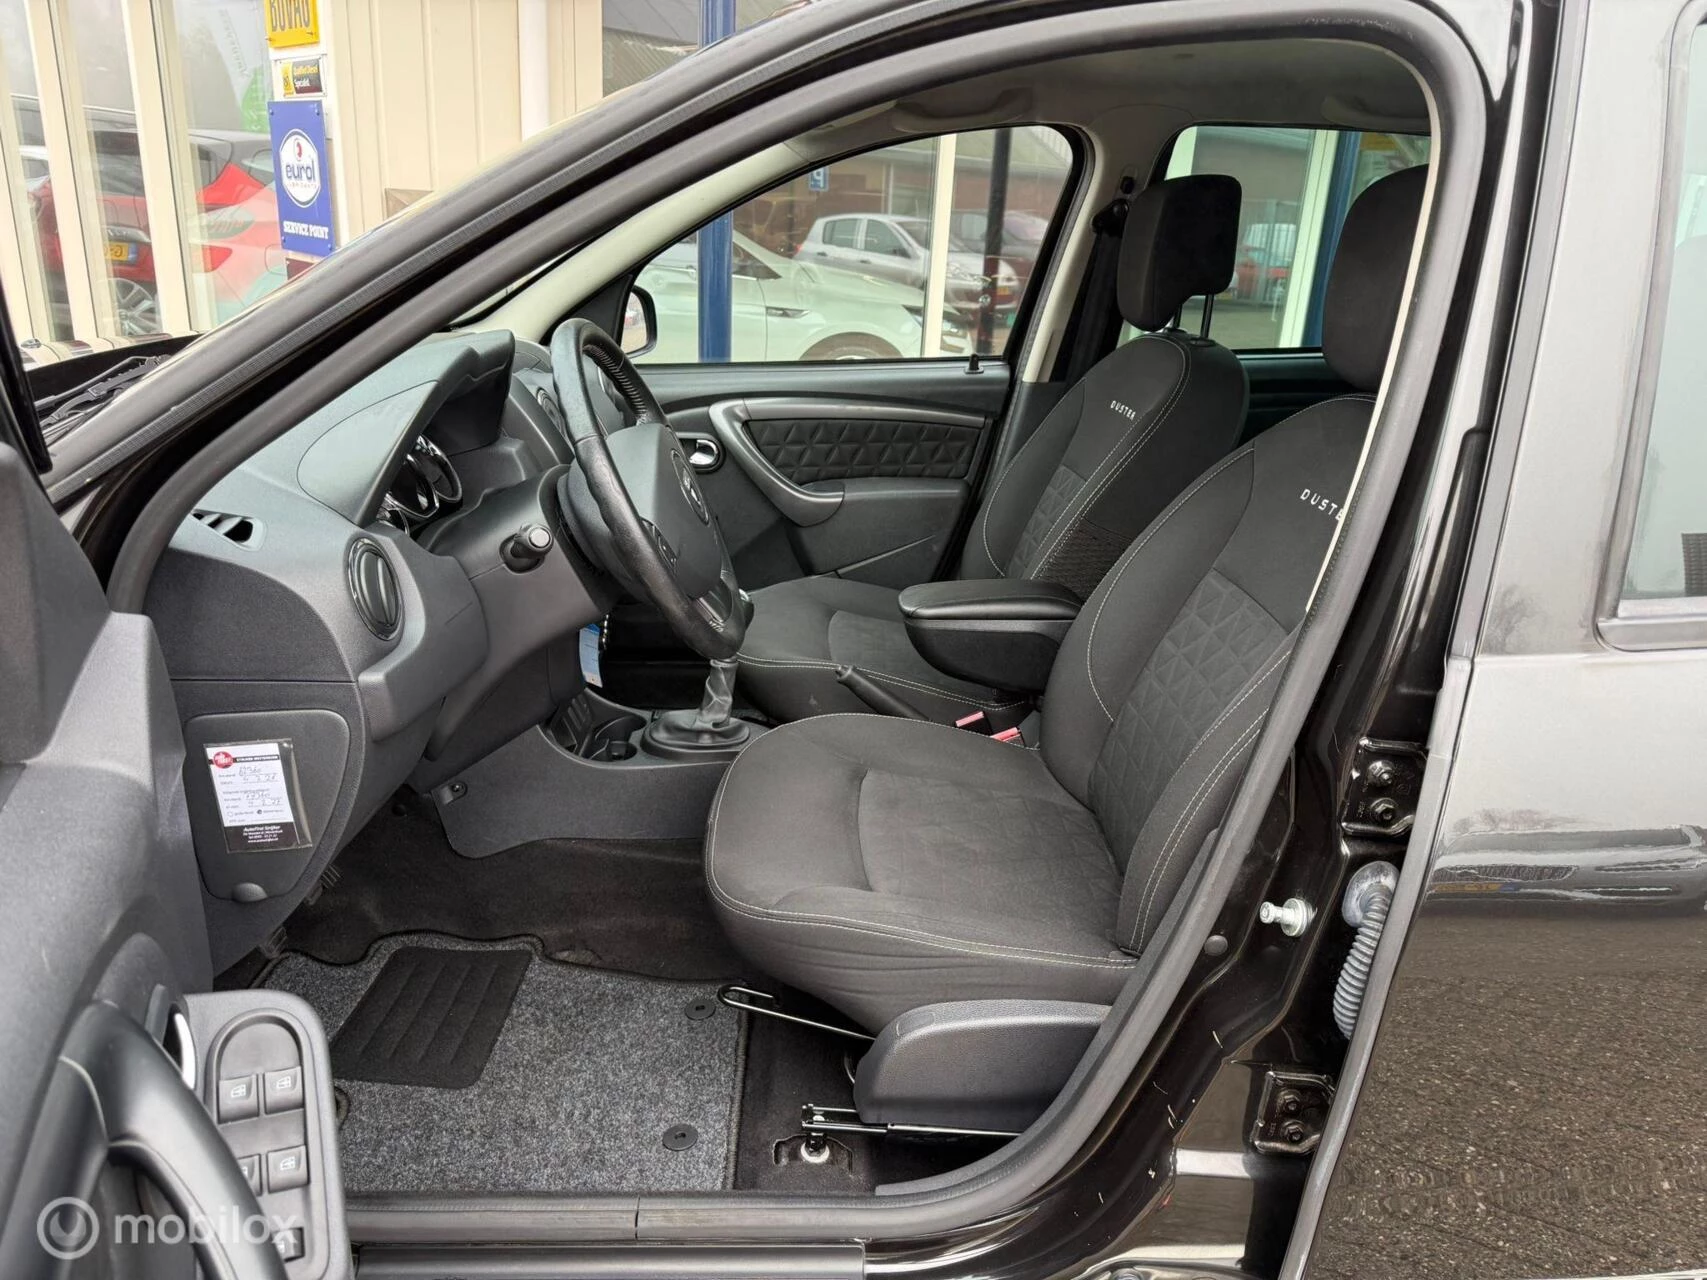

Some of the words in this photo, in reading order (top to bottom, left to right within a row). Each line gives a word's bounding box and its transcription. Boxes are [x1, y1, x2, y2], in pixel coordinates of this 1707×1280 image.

[286, 158, 316, 182] eurol
[283, 220, 309, 236] SERVICE
[308, 224, 329, 239] POINT
[1110, 400, 1136, 421] DUSTER
[1300, 488, 1345, 521] DUSTE
